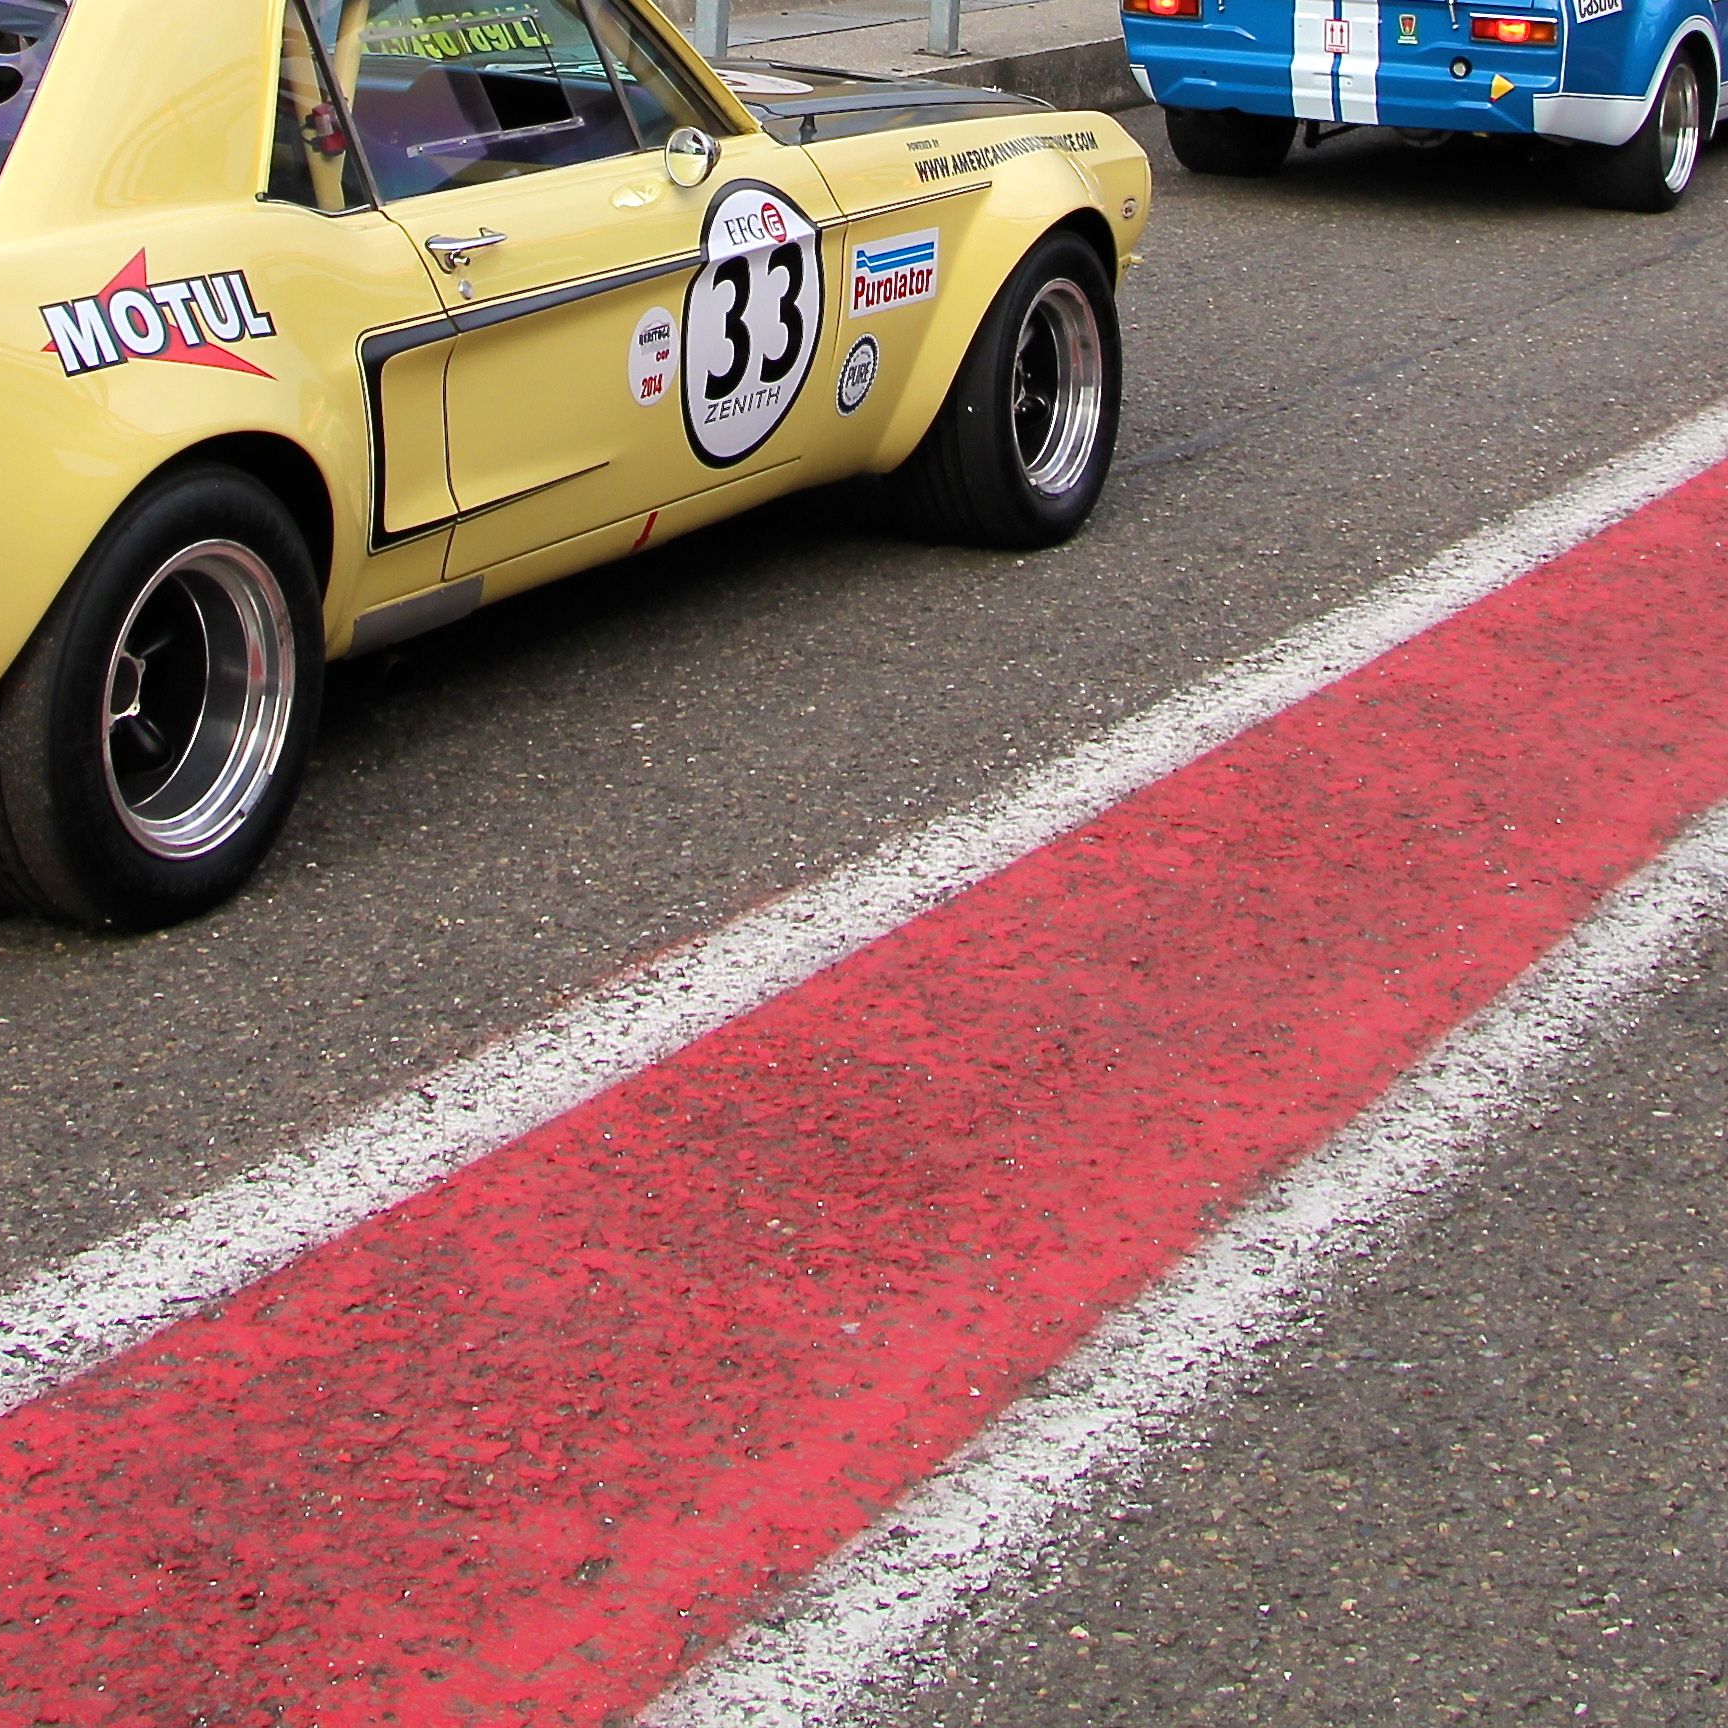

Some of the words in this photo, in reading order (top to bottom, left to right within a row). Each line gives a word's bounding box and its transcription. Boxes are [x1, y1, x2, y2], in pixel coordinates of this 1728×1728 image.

[724, 213, 766, 247] EFG
[853, 266, 934, 311] Purolator
[38, 269, 277, 378] MOTUL
[704, 240, 804, 401] 33
[640, 373, 663, 400] 2014
[845, 361, 872, 387] PURE
[704, 385, 781, 425] ZENITH
